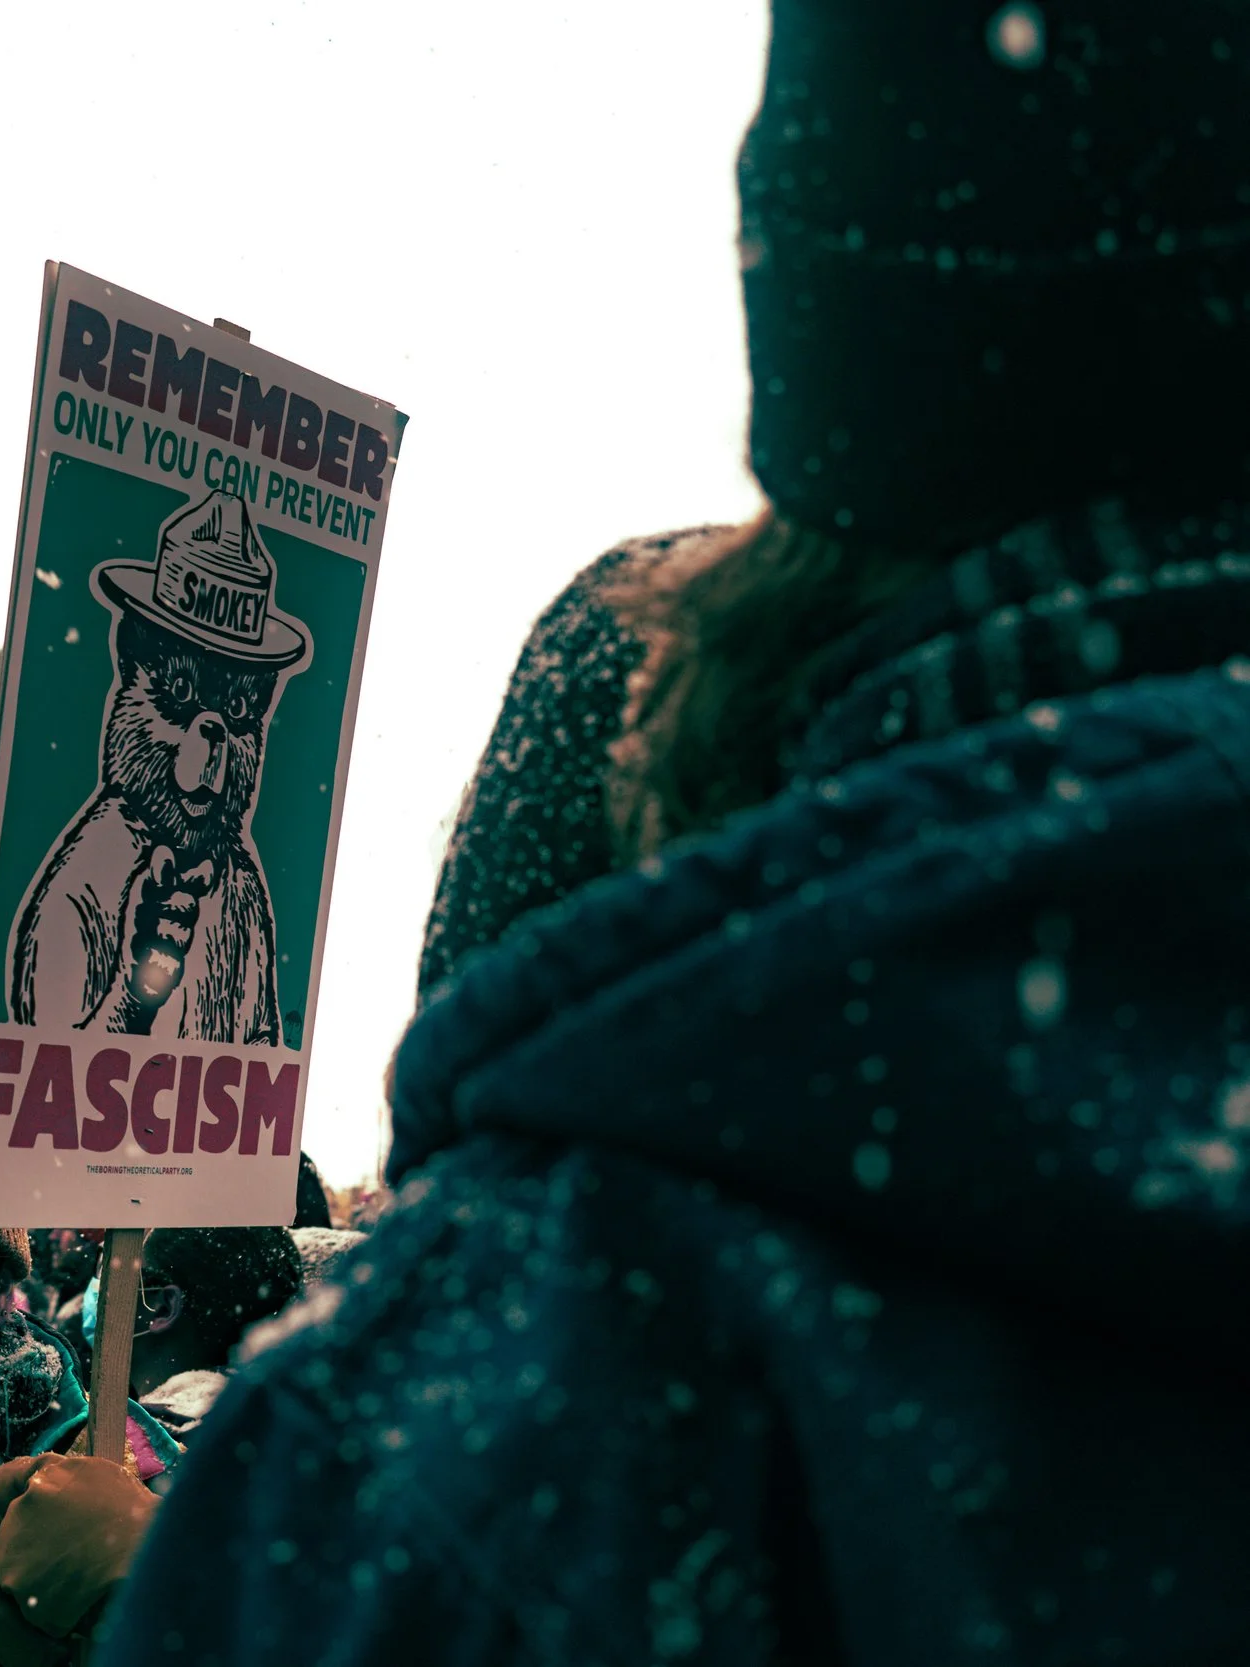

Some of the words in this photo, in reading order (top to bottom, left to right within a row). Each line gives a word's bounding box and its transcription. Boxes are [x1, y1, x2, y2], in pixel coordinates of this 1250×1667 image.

[58, 299, 389, 502] REMEMBER
[53, 391, 134, 455] ONLY
[142, 421, 199, 479] YOU
[204, 447, 261, 503] CAN
[264, 470, 376, 545] PREVENT
[178, 571, 265, 633] SMOKEY
[86, 1165, 193, 1176] THEBORINGTHEORETICALPARTY.ORG
